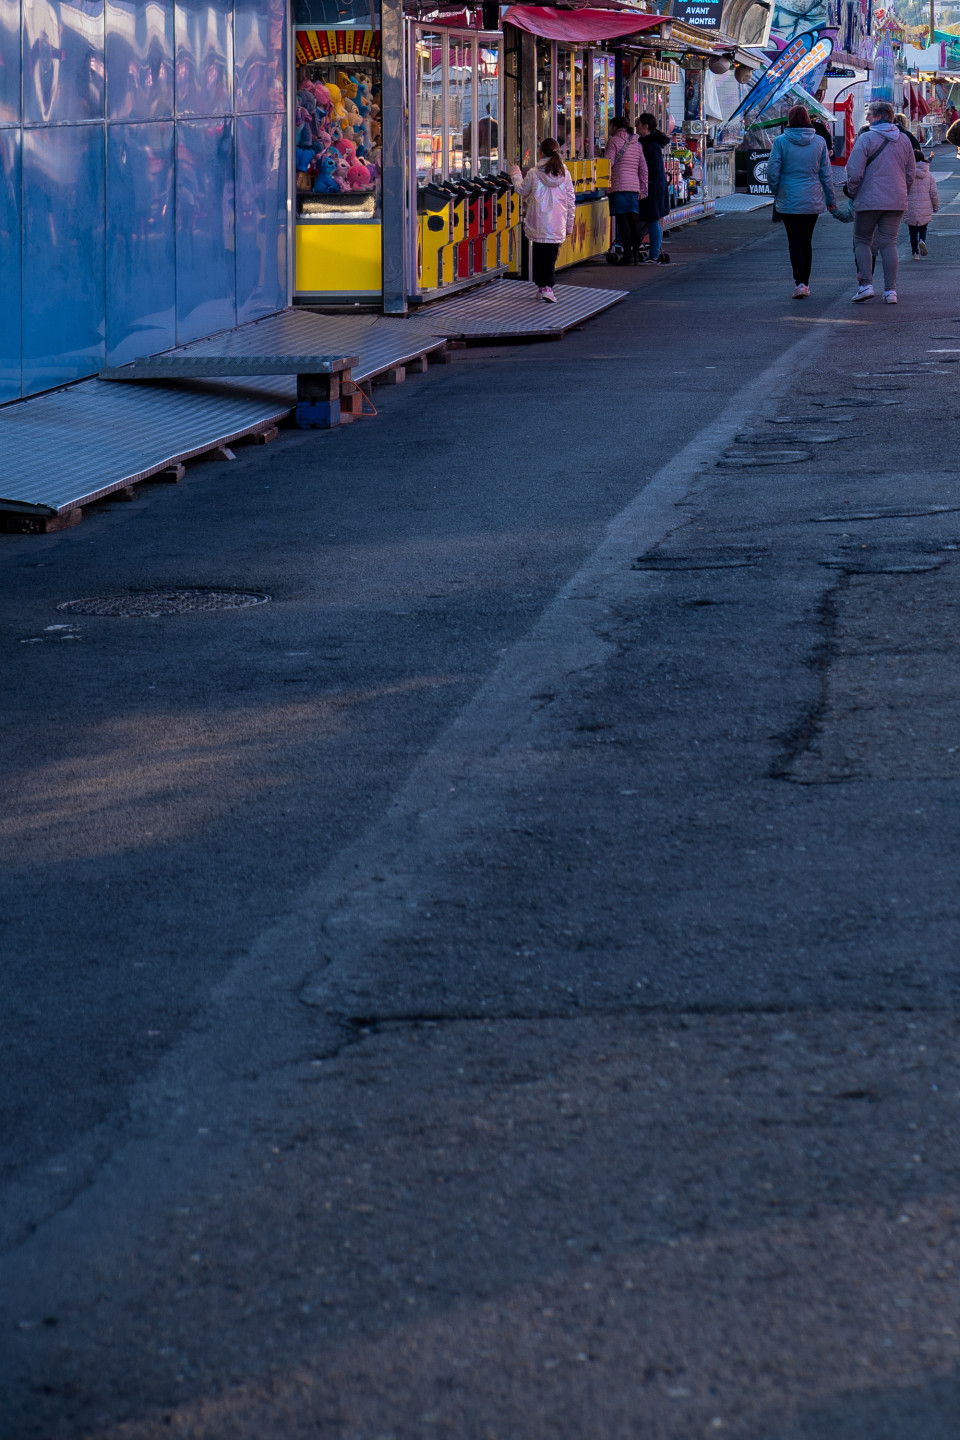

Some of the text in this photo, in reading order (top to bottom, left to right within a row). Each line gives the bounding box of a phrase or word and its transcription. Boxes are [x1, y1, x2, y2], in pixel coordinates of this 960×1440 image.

[685, 6, 710, 14] AVANT
[688, 17, 716, 25] MONTER
[749, 184, 773, 194] YAMA
